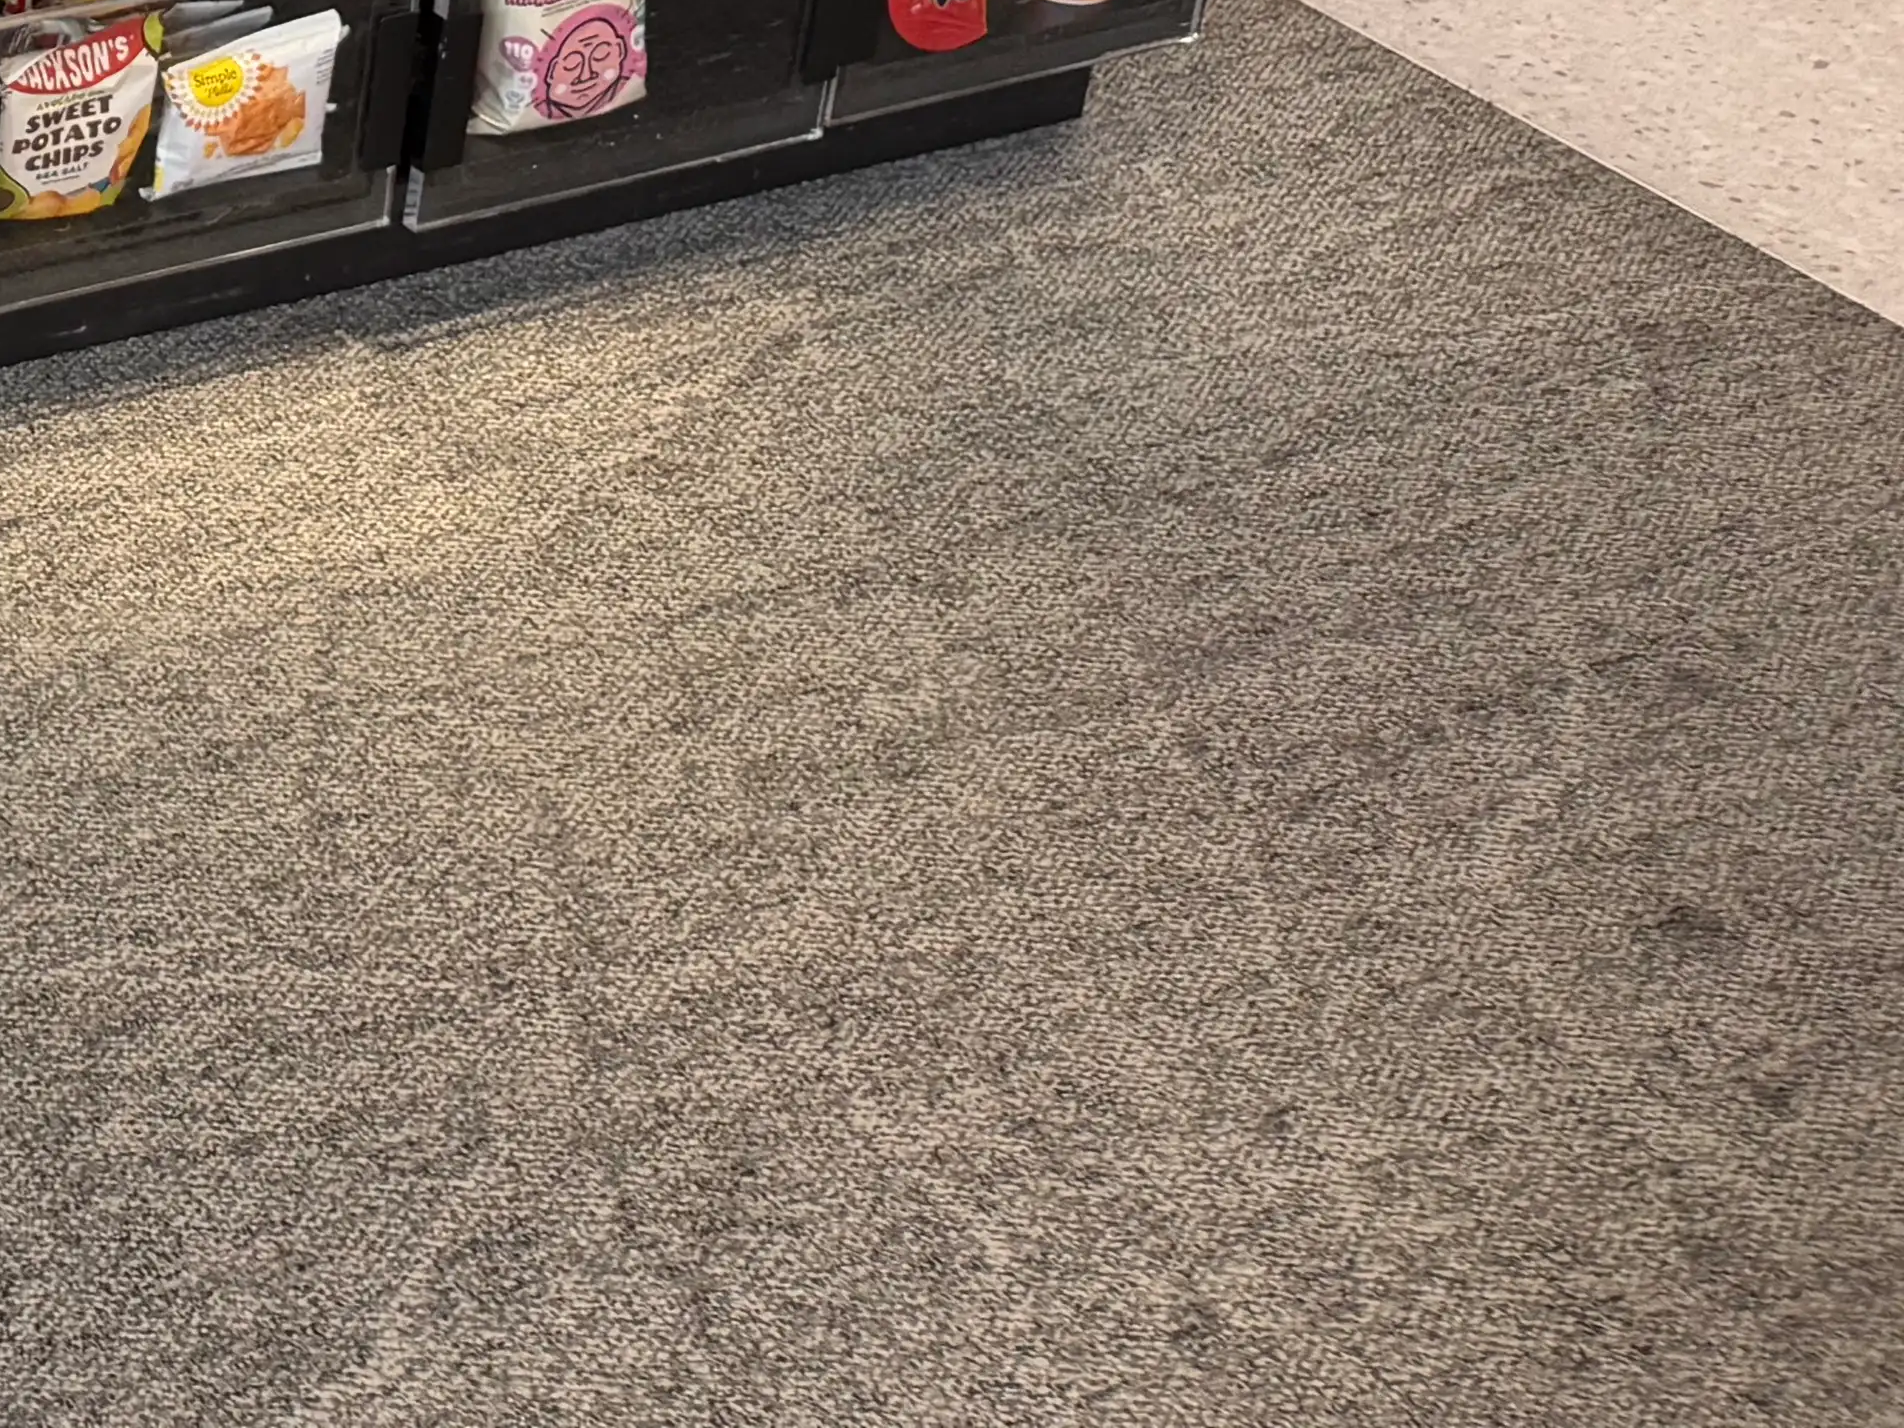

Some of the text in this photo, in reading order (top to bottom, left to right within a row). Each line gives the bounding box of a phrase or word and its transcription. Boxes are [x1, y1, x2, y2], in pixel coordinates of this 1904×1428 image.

[24, 94, 114, 135] SWEET
[12, 117, 123, 155] POTATO
[24, 141, 104, 173] CHIPS
